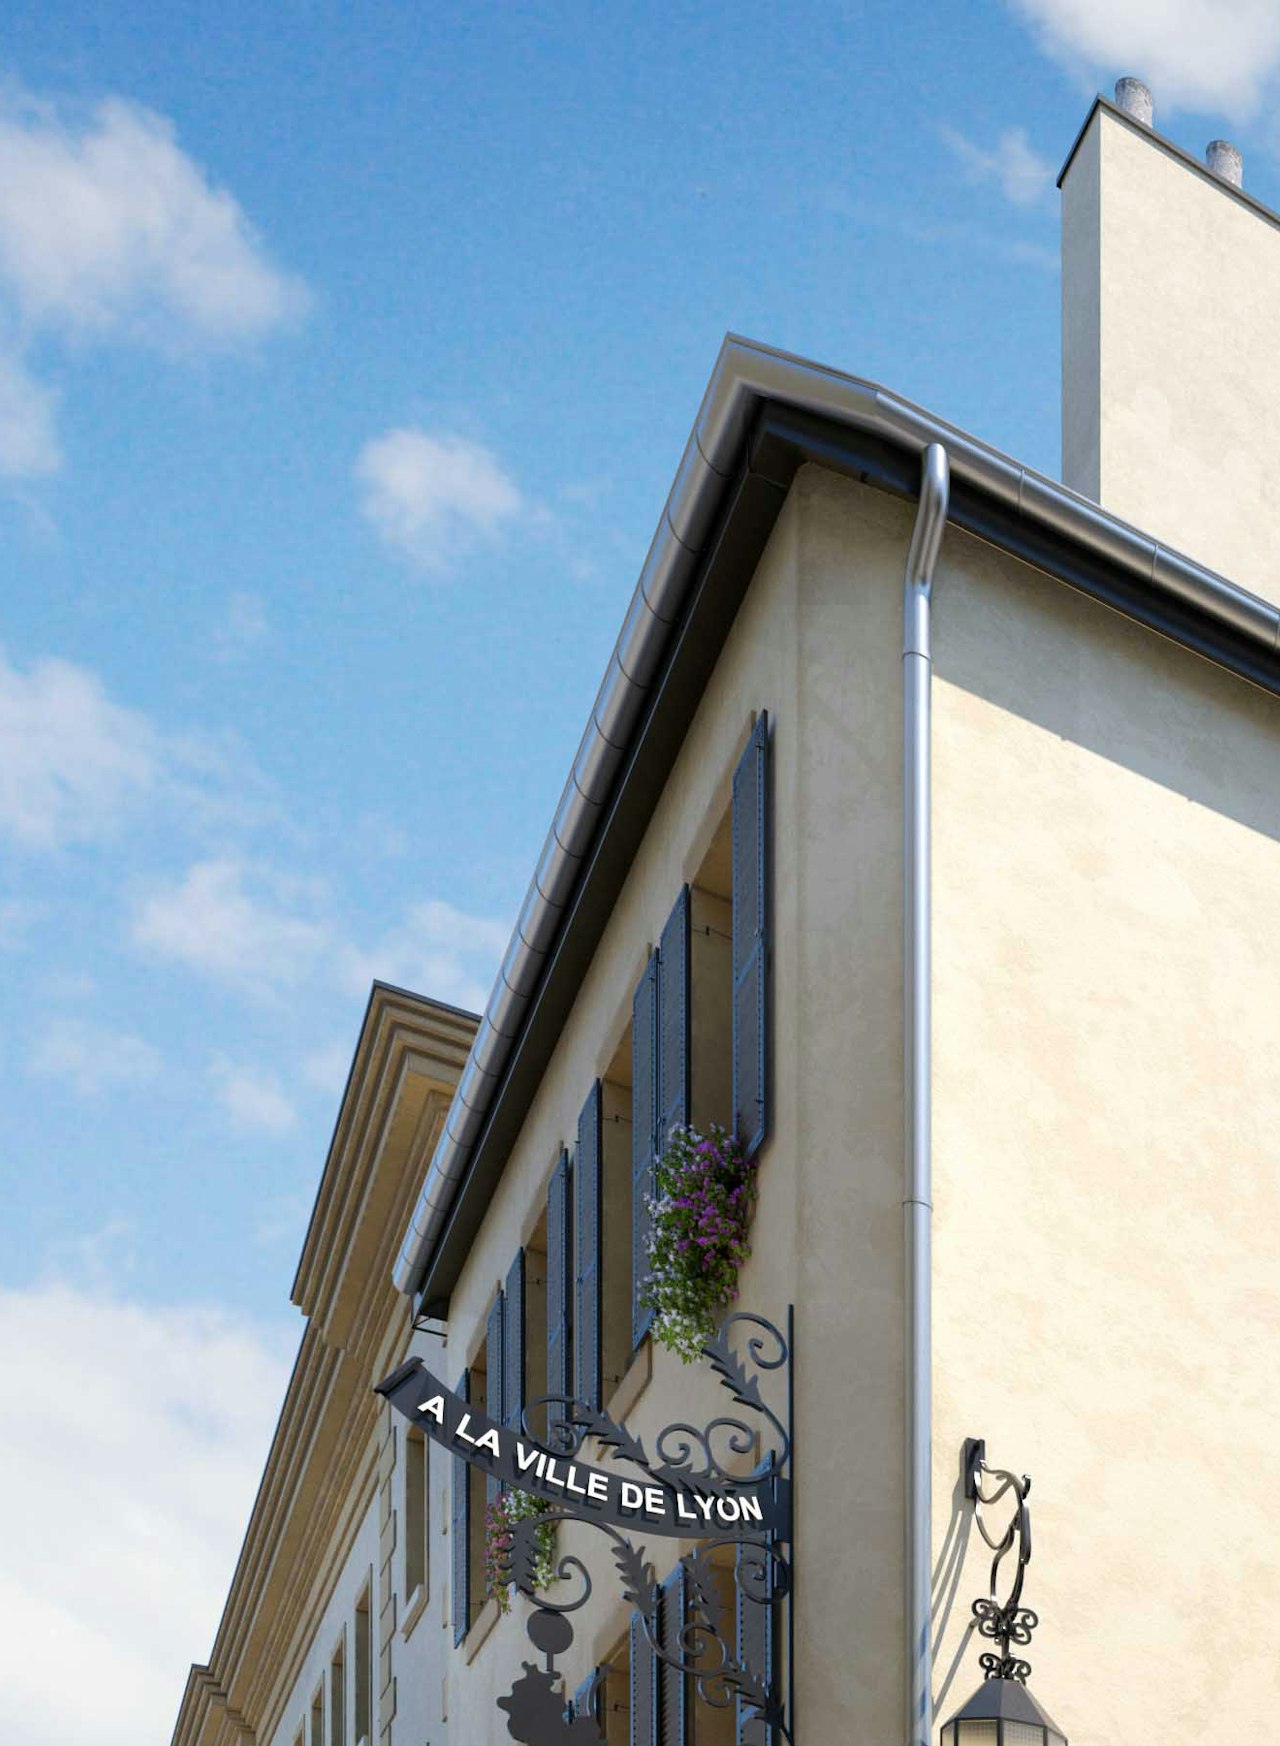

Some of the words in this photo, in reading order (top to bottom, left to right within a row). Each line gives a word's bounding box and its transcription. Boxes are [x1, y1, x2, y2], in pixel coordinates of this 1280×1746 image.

[417, 1395, 445, 1425] A
[455, 1413, 500, 1458] LA
[516, 1441, 609, 1502] VILLE
[621, 1481, 666, 1515] DE
[676, 1492, 764, 1522] LYON
